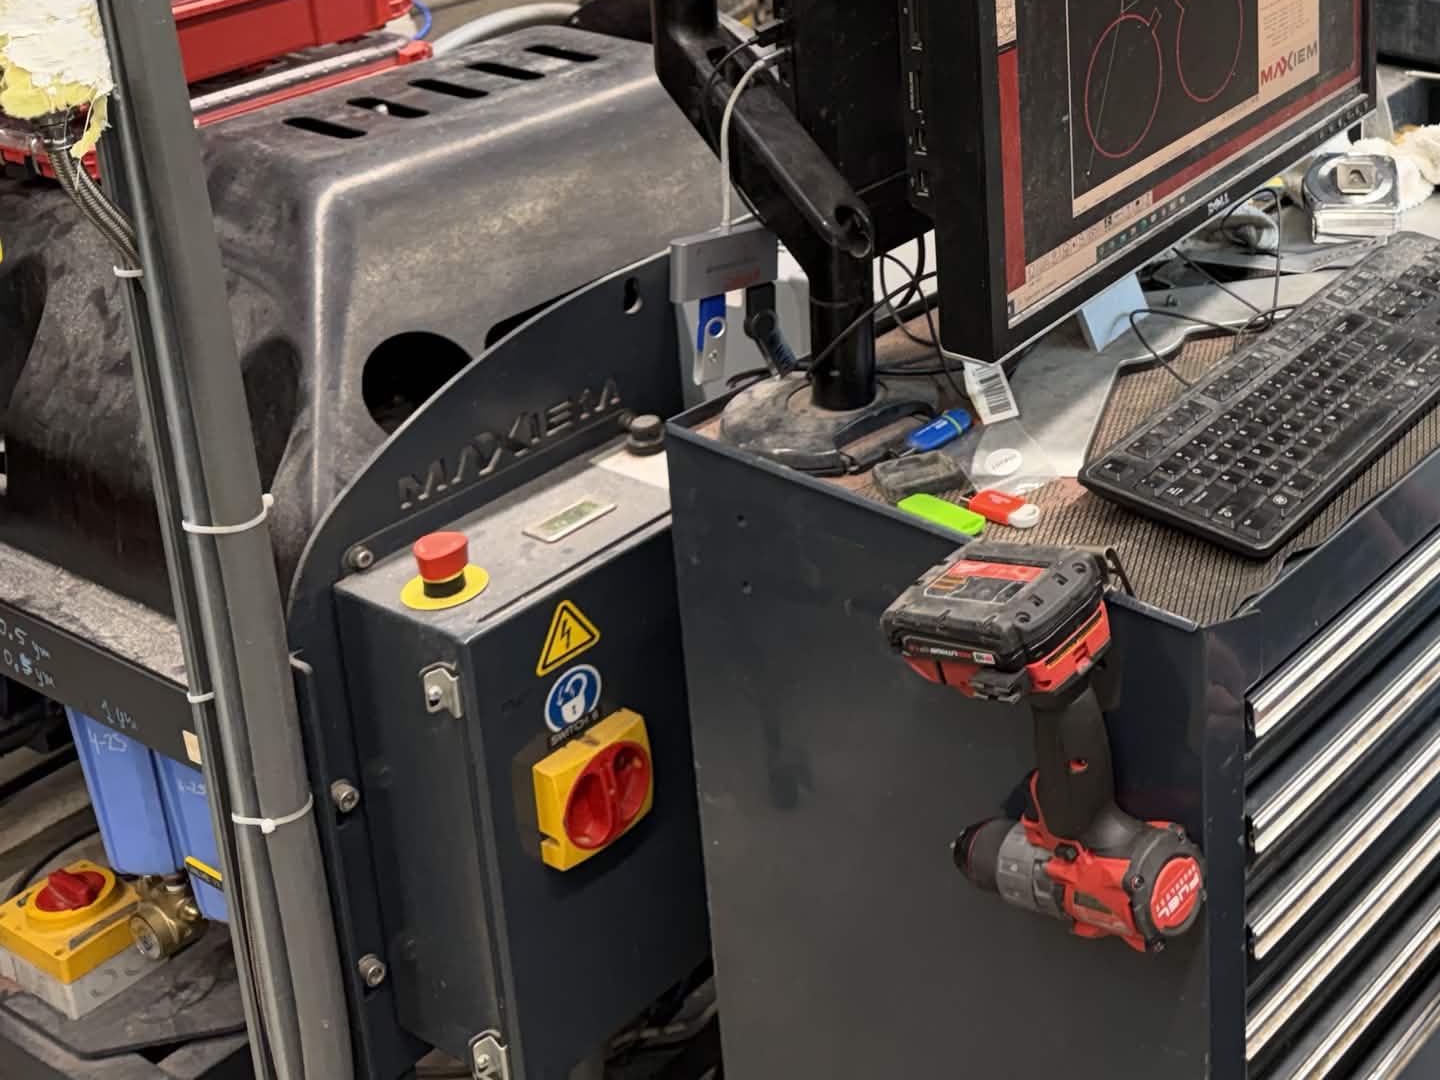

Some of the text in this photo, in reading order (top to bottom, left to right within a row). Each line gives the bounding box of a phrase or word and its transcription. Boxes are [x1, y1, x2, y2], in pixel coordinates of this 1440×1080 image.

[1260, 39, 1318, 87] MAXIEM
[1207, 192, 1231, 216] DELL
[398, 377, 622, 510] MAXIEM
[1157, 871, 1200, 919] FUEL
